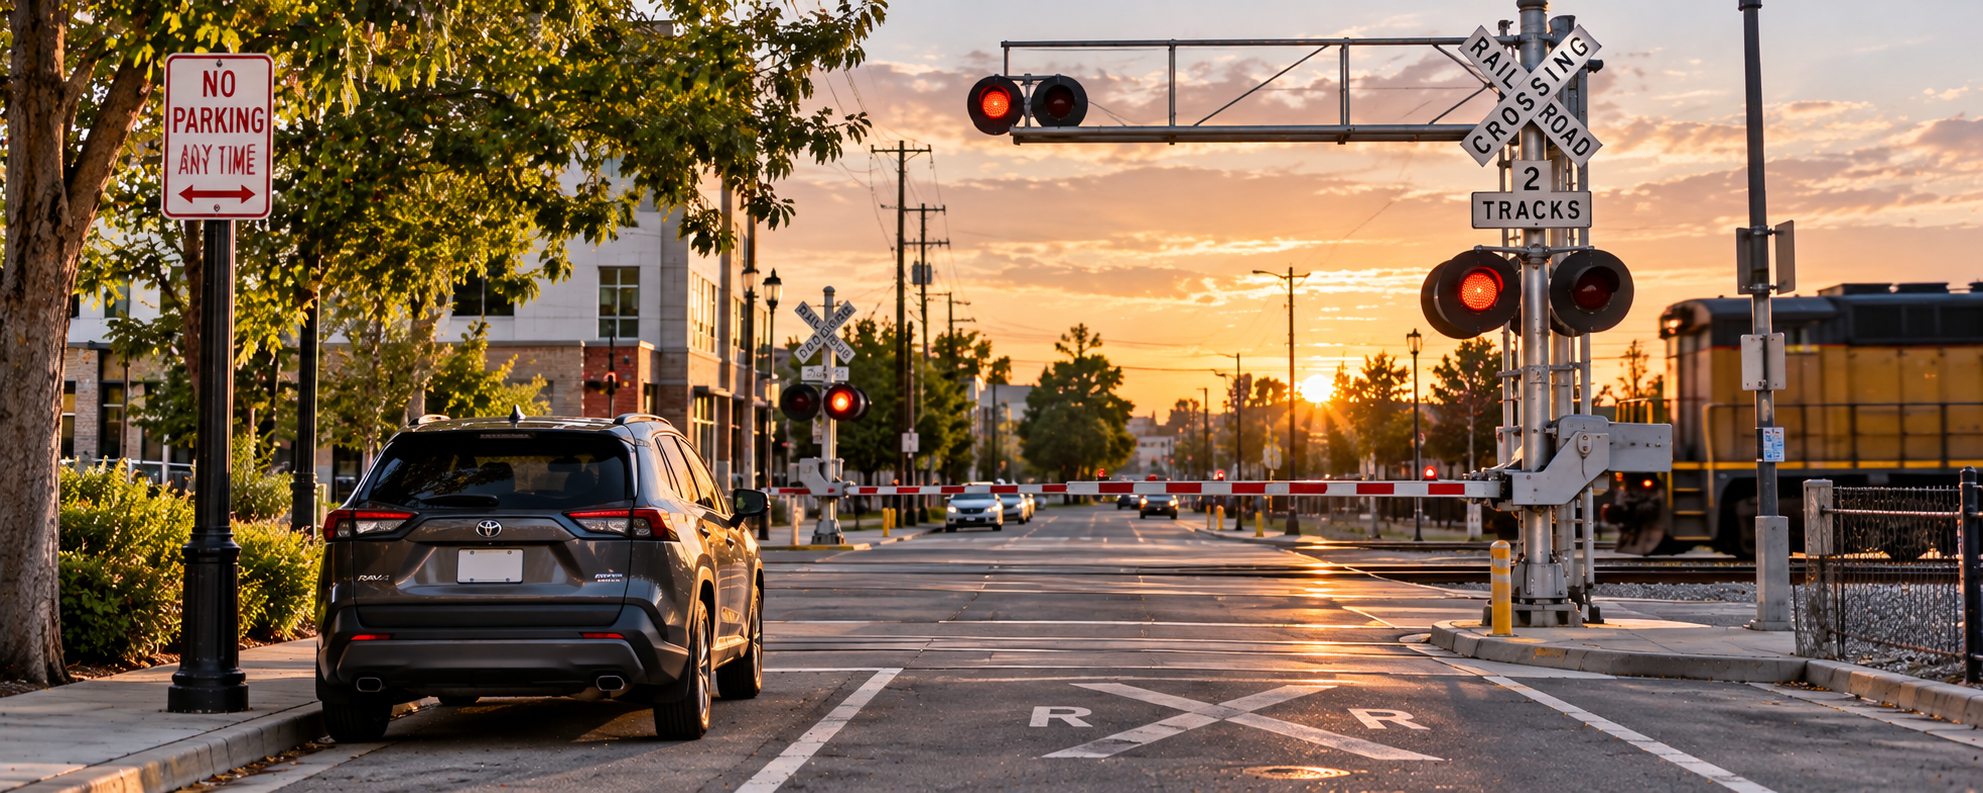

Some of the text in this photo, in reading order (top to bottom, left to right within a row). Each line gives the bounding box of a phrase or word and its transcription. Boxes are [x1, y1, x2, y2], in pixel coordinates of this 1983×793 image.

[202, 70, 236, 98] NO
[1470, 36, 1591, 156] RAIL ROAD
[1472, 36, 1589, 154] CROSSING
[173, 107, 264, 134] PARKING
[178, 144, 256, 175] ANY TIME
[1523, 166, 1540, 191] 2
[1482, 200, 1580, 220] TRACKS
[1028, 705, 1093, 728] R
[1347, 708, 1431, 730] R
